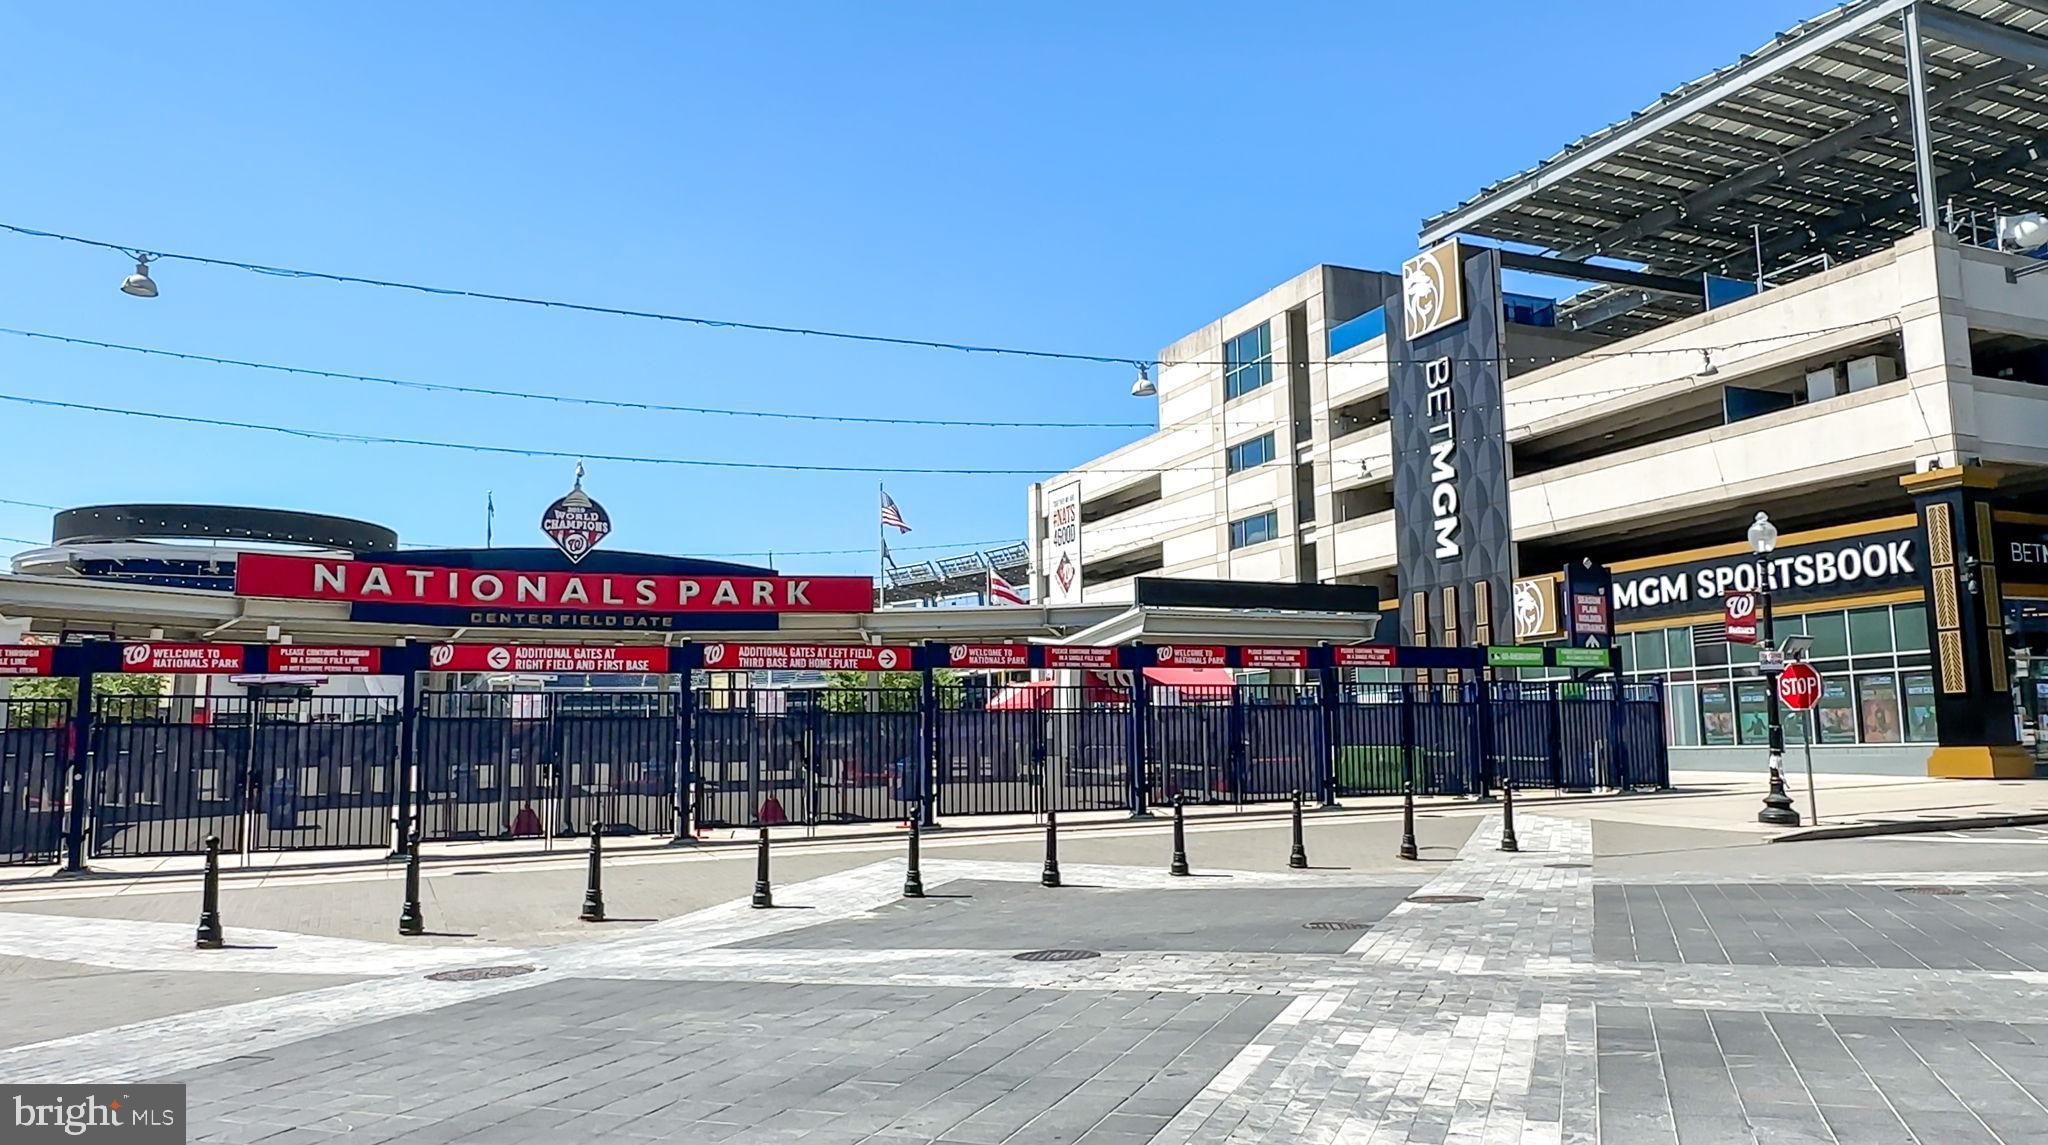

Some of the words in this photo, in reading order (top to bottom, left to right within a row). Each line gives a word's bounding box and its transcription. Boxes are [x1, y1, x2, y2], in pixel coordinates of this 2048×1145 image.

[1425, 357, 1459, 559] BETMGM
[554, 509, 599, 521] WORLD
[544, 519, 608, 533] CHAMPIONS
[1613, 573, 1688, 610] MGM
[1697, 540, 1915, 597] SPORTSBOOK
[313, 563, 657, 605] NATIONALS
[679, 580, 811, 606] PARK
[470, 612, 554, 625] CENTER
[560, 614, 617, 626] FIELD
[623, 616, 673, 627] GATE
[153, 649, 204, 658] WELCOME
[207, 649, 220, 658] TO
[281, 648, 305, 656] PLEASE
[515, 648, 571, 659] ADDITIONAL
[574, 648, 602, 660] GATES
[604, 649, 616, 660] AT
[738, 647, 788, 658] ADDITIONAL
[790, 647, 815, 658] GATES
[817, 648, 828, 658] AT
[829, 648, 848, 659] LEFT
[850, 649, 875, 661] FIELD,
[968, 648, 1003, 656] WELCOME
[1004, 649, 1013, 657] TO
[1174, 649, 1204, 657] WELCOME
[153, 659, 208, 668] NATIONALS
[211, 659, 239, 668] PARK
[515, 659, 543, 670] RIGHT
[546, 660, 574, 671] FIELD
[576, 660, 595, 671] AND
[597, 660, 624, 671] FIRST
[626, 660, 649, 671] BASE
[739, 657, 764, 668] THIRD
[766, 658, 788, 668] BASE
[789, 658, 807, 668] AND
[809, 659, 832, 669] HOME
[834, 659, 859, 669] PLATE
[968, 656, 1006, 664] NATIONALS
[1781, 677, 1816, 695] STOP
